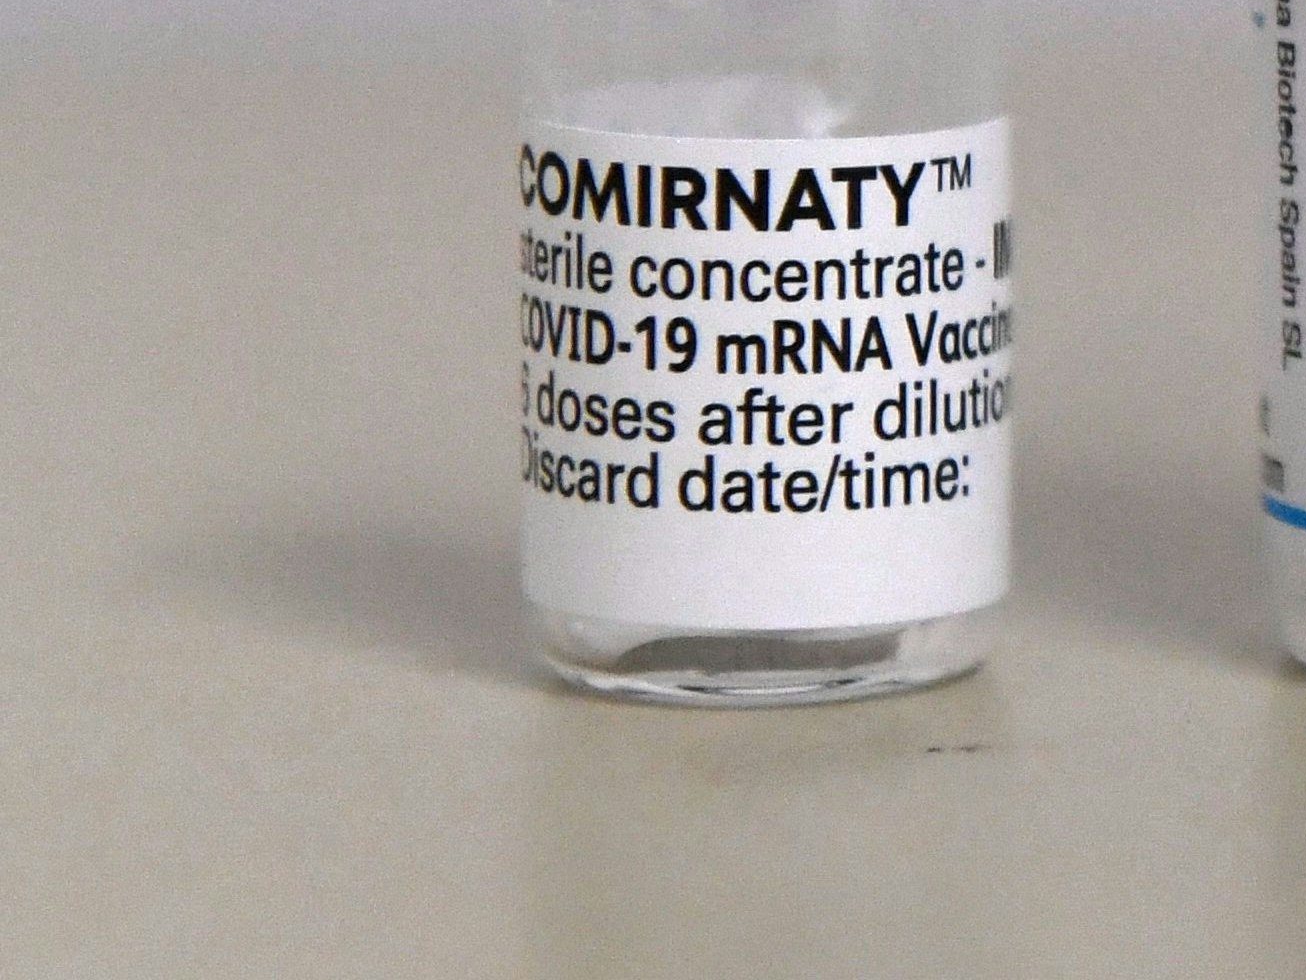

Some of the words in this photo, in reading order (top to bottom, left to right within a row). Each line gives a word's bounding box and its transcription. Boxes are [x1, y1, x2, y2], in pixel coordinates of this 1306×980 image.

[1276, 41, 1298, 186] Biotech
[630, 243, 964, 303] concentrate
[1279, 197, 1301, 308] Spain
[521, 294, 698, 374] COVID-19
[718, 317, 893, 375] mRNA
[904, 300, 1012, 367] Vaccin
[537, 370, 675, 443] doses
[699, 387, 853, 446] after
[874, 369, 1012, 440] dilutio
[522, 425, 658, 510] Discard
[678, 453, 970, 513] date/time:
